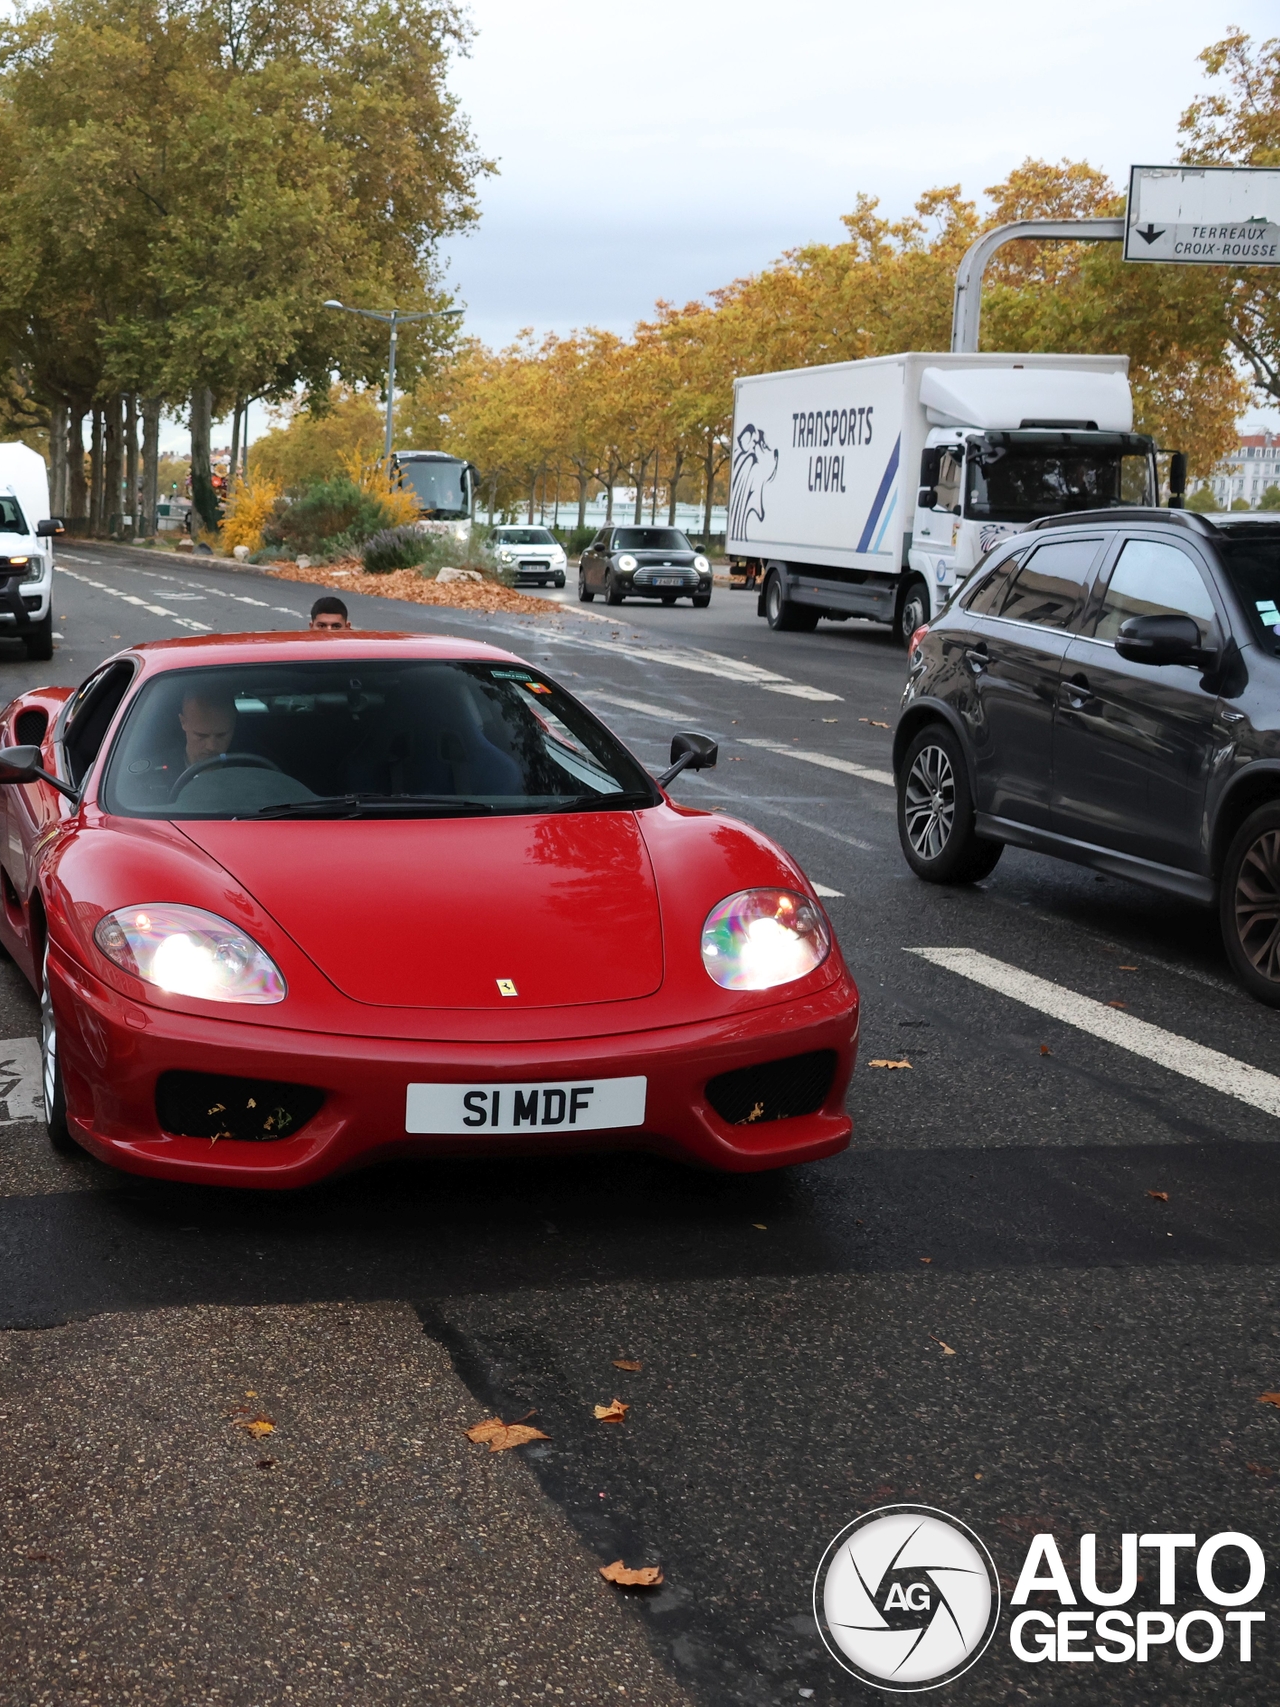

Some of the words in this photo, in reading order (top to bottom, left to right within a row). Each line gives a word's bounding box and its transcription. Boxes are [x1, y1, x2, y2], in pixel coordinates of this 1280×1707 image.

[1174, 242, 1278, 257] CROIX-ROUSSE
[1192, 226, 1267, 240] TERREAUX
[792, 405, 874, 449] TRANSPORTS
[807, 455, 846, 494] LAVAL
[512, 1086, 594, 1127] MDF
